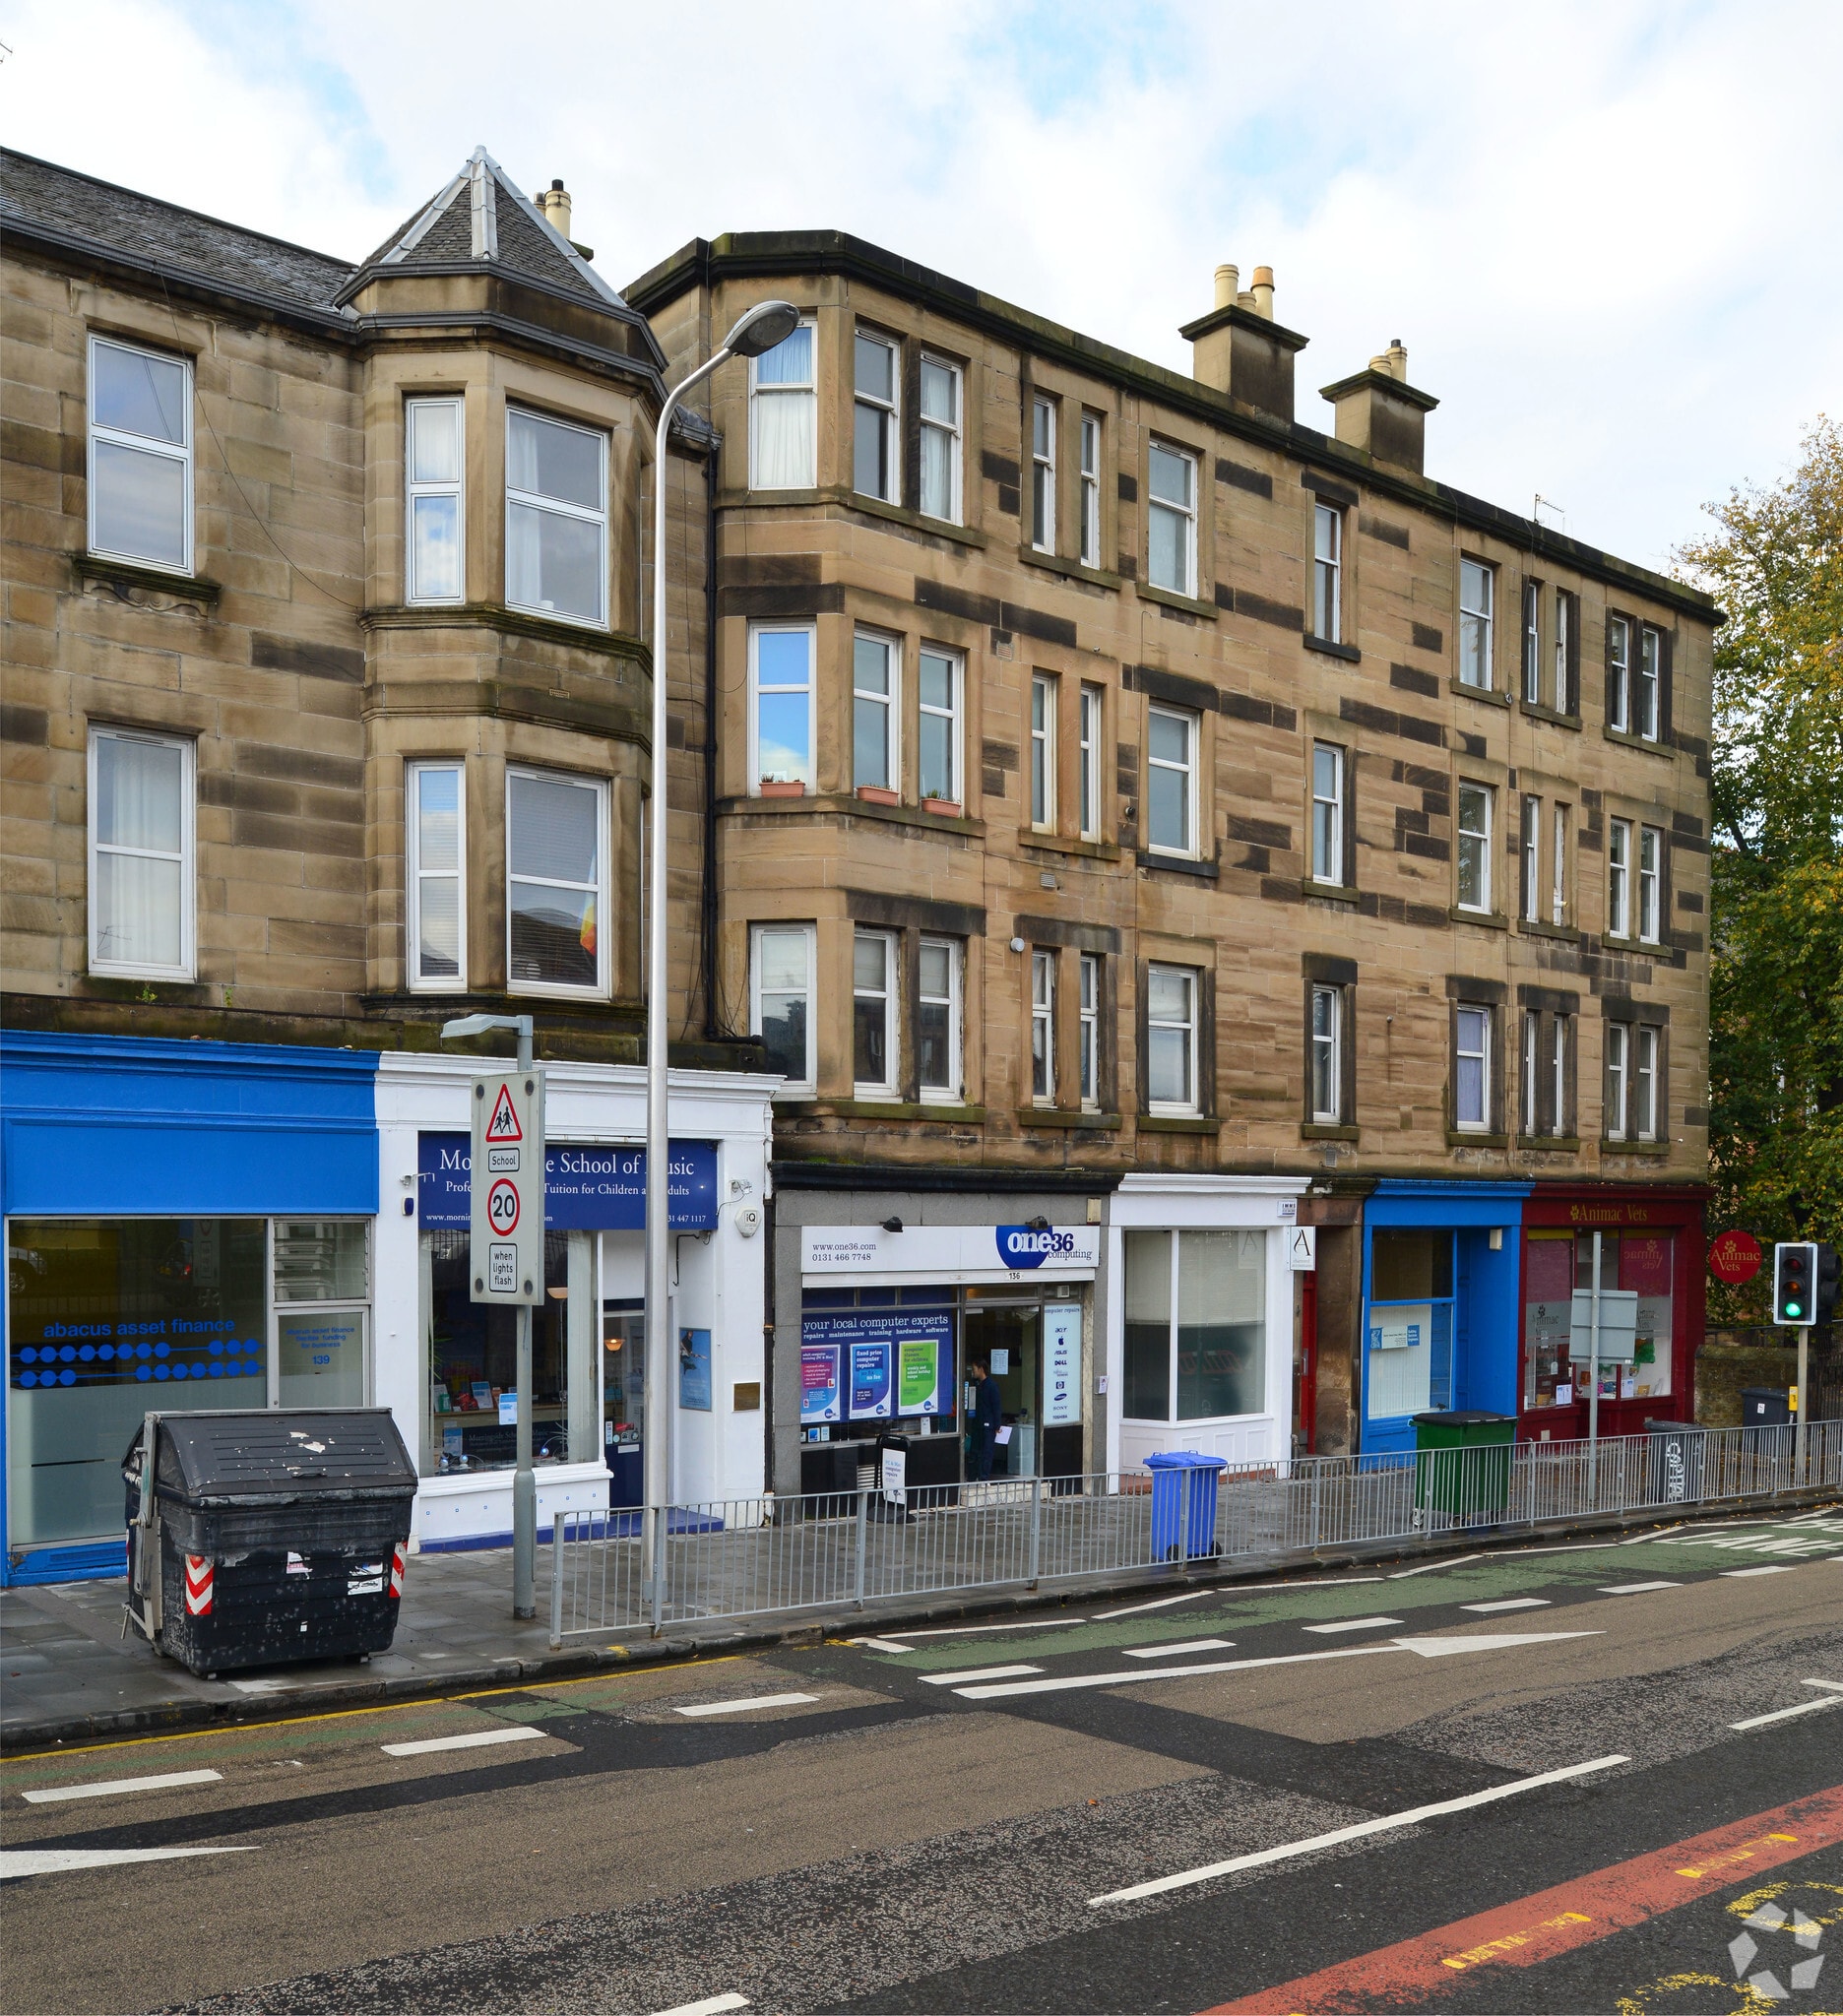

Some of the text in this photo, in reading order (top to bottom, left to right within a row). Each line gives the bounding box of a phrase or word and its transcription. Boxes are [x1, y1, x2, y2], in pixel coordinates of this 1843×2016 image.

[491, 1156, 517, 1166] School
[559, 1153, 616, 1173] School
[622, 1154, 642, 1173] of
[544, 1183, 578, 1194] Tuition
[581, 1183, 595, 1194] for
[598, 1184, 639, 1195] Children
[667, 1185, 689, 1196] dults
[492, 1194, 516, 1218] 20
[1578, 1203, 1648, 1222] Animac Vets
[812, 1242, 876, 1251] www.one36.com
[1007, 1231, 1074, 1253] one36
[1293, 1228, 1311, 1256] A
[494, 1251, 513, 1261] when
[811, 1253, 833, 1262] 0131
[834, 1253, 850, 1262] 466
[1048, 1249, 1092, 1261] computing
[1710, 1248, 1760, 1261] Animac
[492, 1263, 513, 1274] lights
[1718, 1257, 1741, 1271] Vets
[494, 1275, 512, 1286] flash
[1008, 1272, 1021, 1281] 136
[43, 1318, 235, 1338] abacus asset finance
[803, 1314, 948, 1333] your local computer experts
[313, 1354, 331, 1365] 139
[1652, 1531, 1843, 1557] LANE
